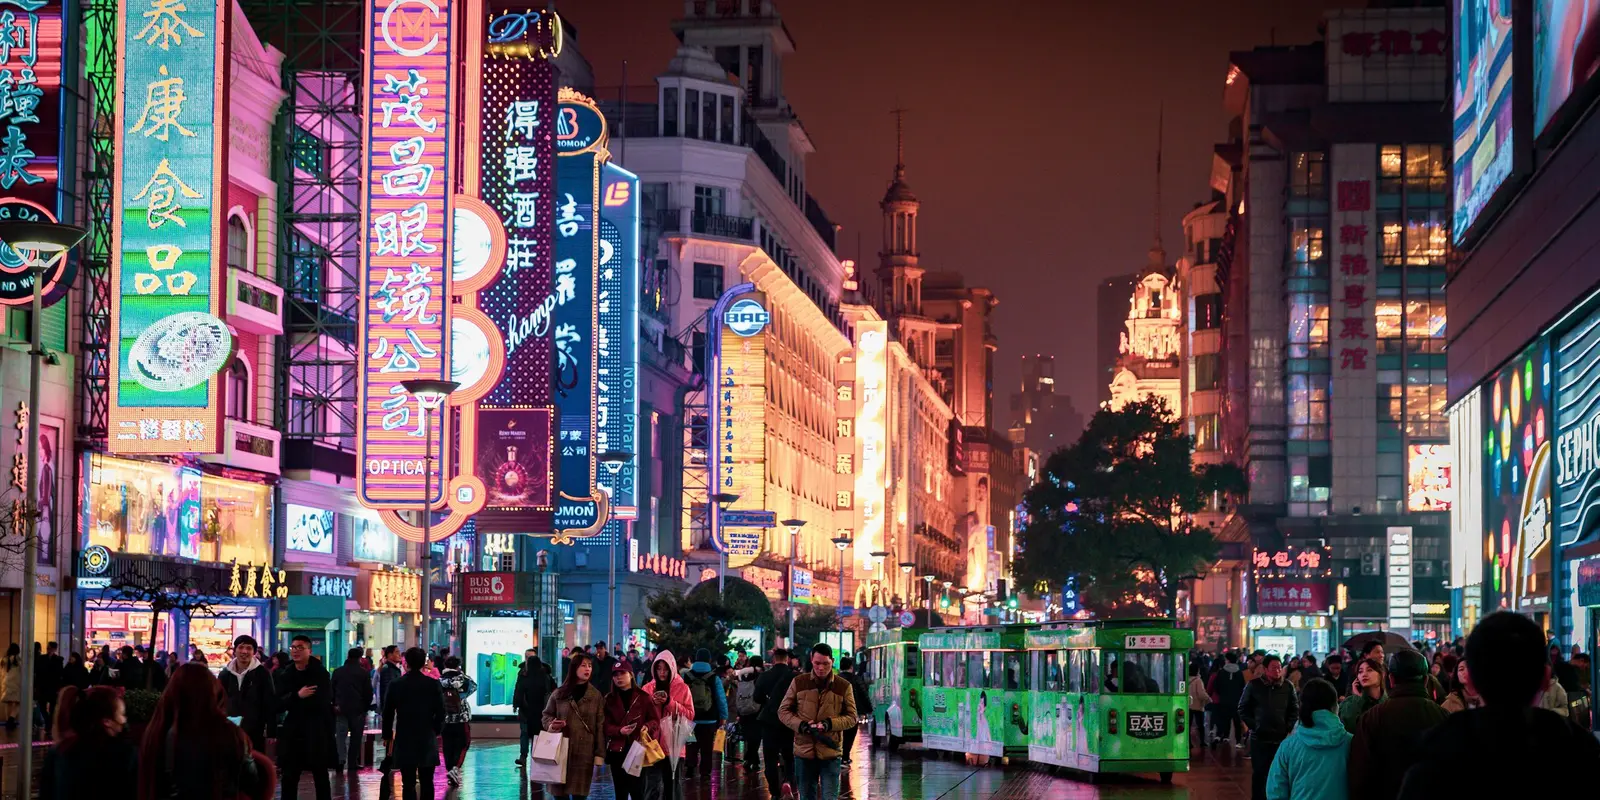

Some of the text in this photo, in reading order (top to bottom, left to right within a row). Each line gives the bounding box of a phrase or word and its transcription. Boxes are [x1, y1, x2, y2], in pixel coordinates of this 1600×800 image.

[371, 68, 437, 437] 茂昌眼镜公司
[369, 459, 434, 475] OPTICA
[620, 413, 634, 495] Pharacy
[229, 558, 288, 598] 泰康食品
[470, 577, 490, 587] BUS
[1129, 715, 1164, 731] 豆本豆
